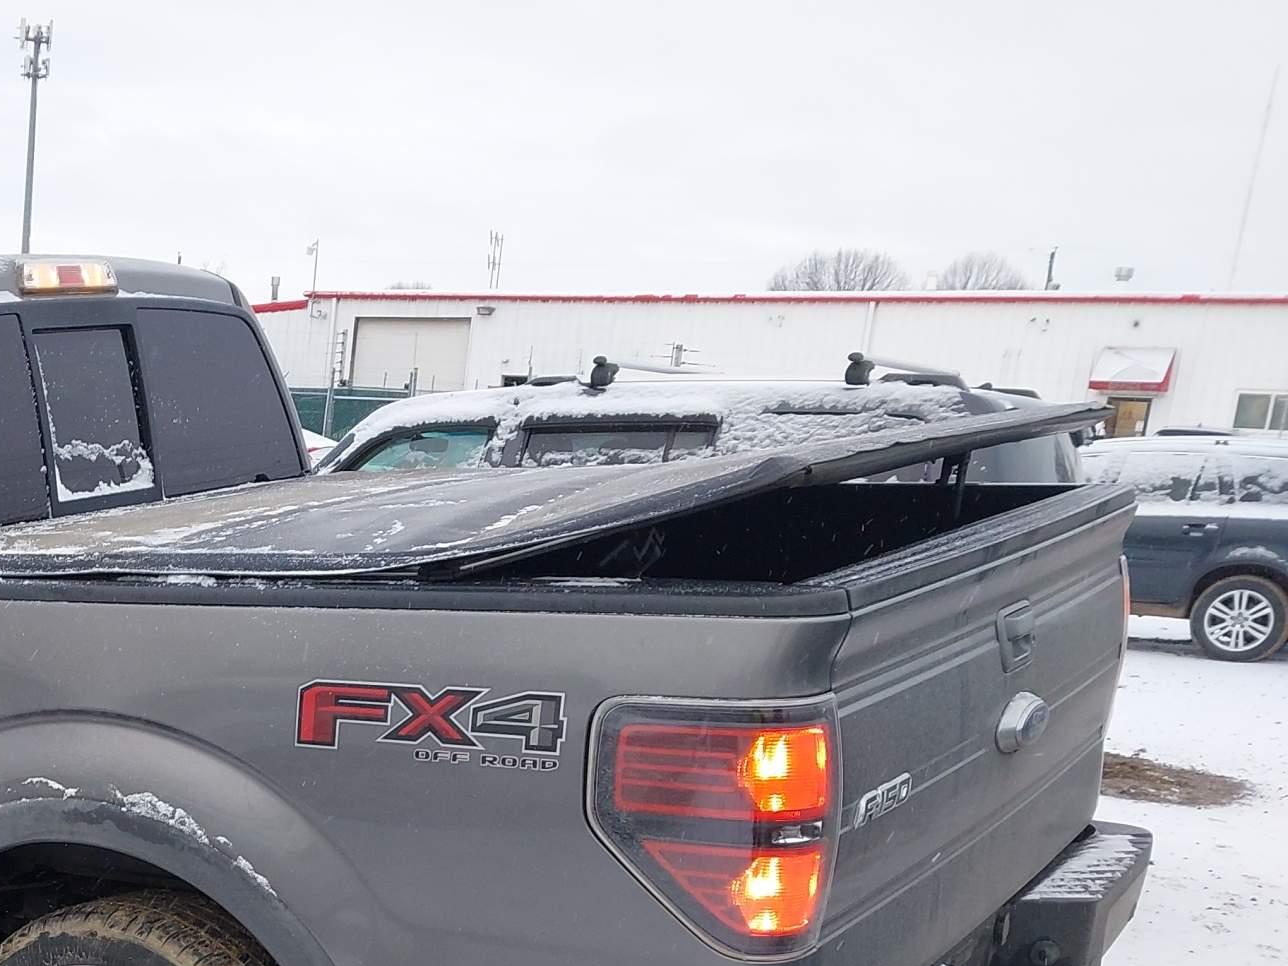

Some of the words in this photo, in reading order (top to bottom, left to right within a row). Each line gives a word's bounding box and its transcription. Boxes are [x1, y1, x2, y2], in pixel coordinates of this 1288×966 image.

[295, 679, 567, 755] FX4
[414, 749, 470, 763] OFF
[479, 754, 560, 771] ROAD
